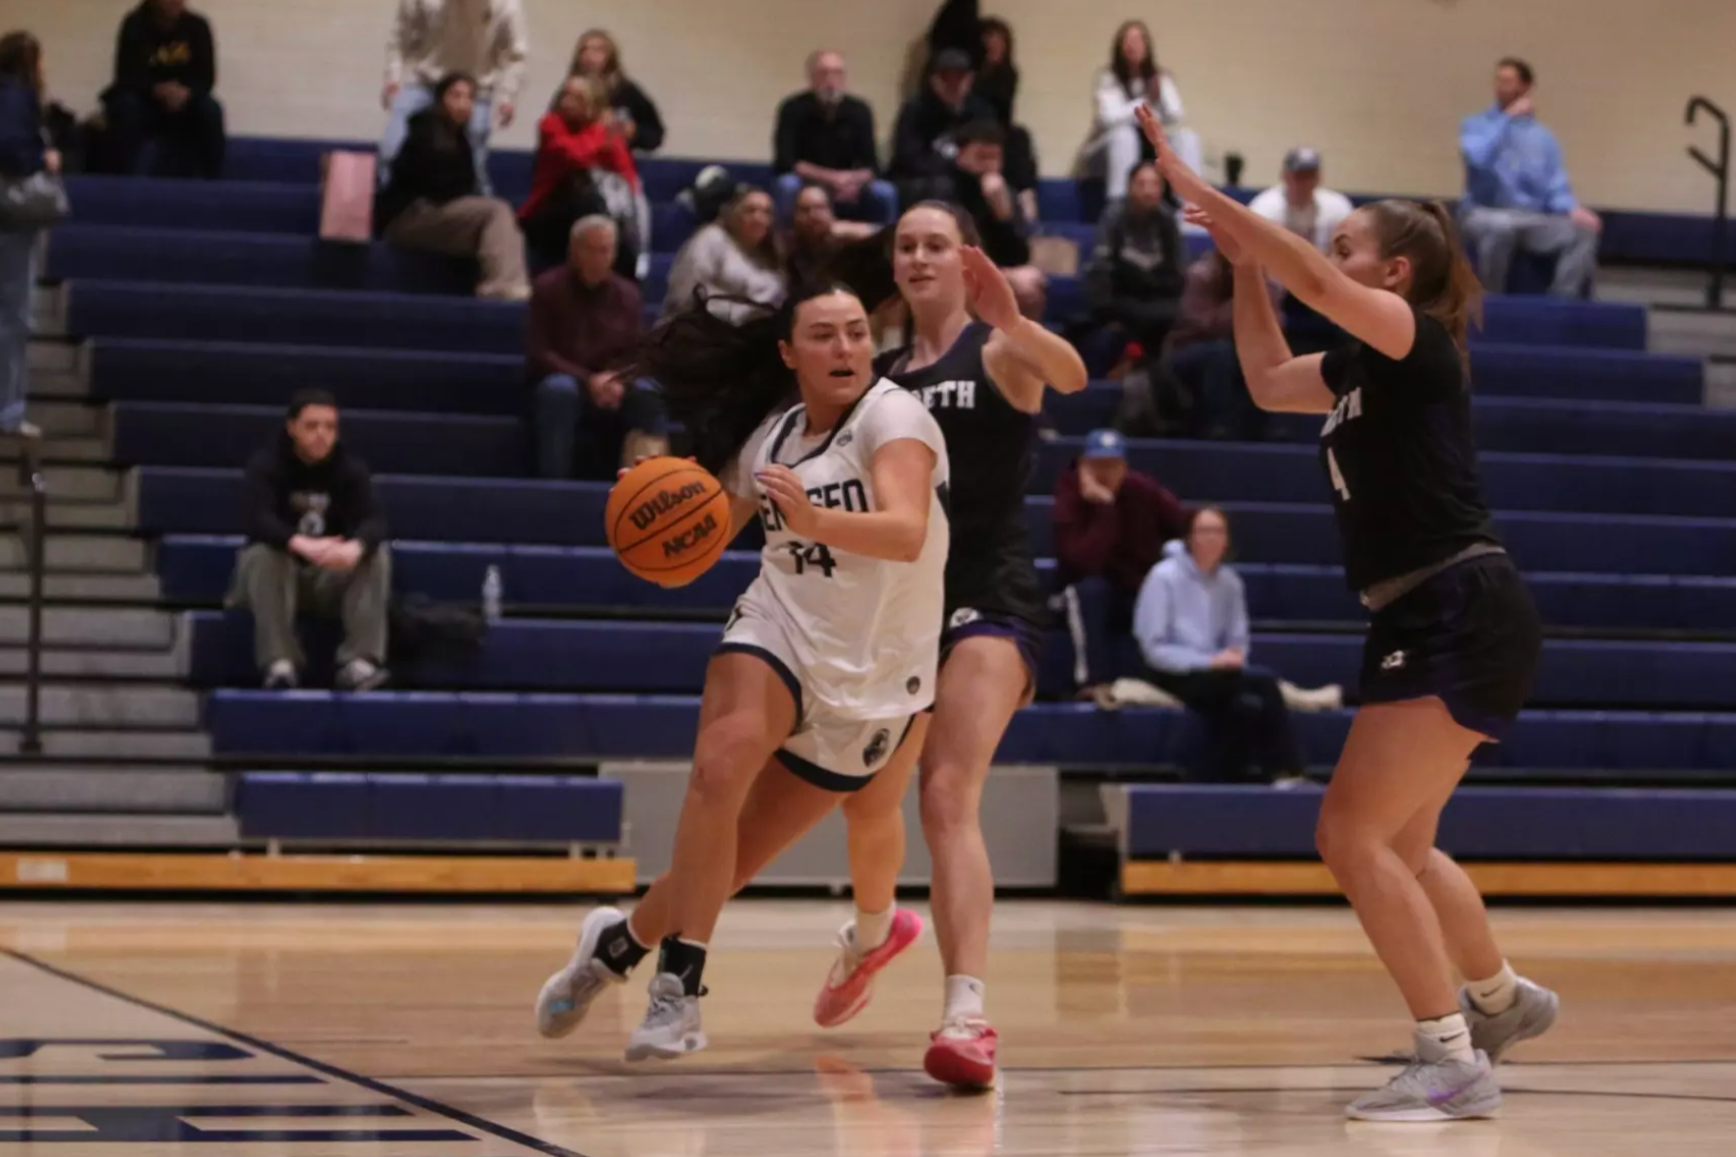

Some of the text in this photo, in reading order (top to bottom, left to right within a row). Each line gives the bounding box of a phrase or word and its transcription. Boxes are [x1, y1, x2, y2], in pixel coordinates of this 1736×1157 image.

[629, 481, 706, 530] Wilson
[661, 511, 718, 558] NCAA
[787, 541, 838, 578] 14
